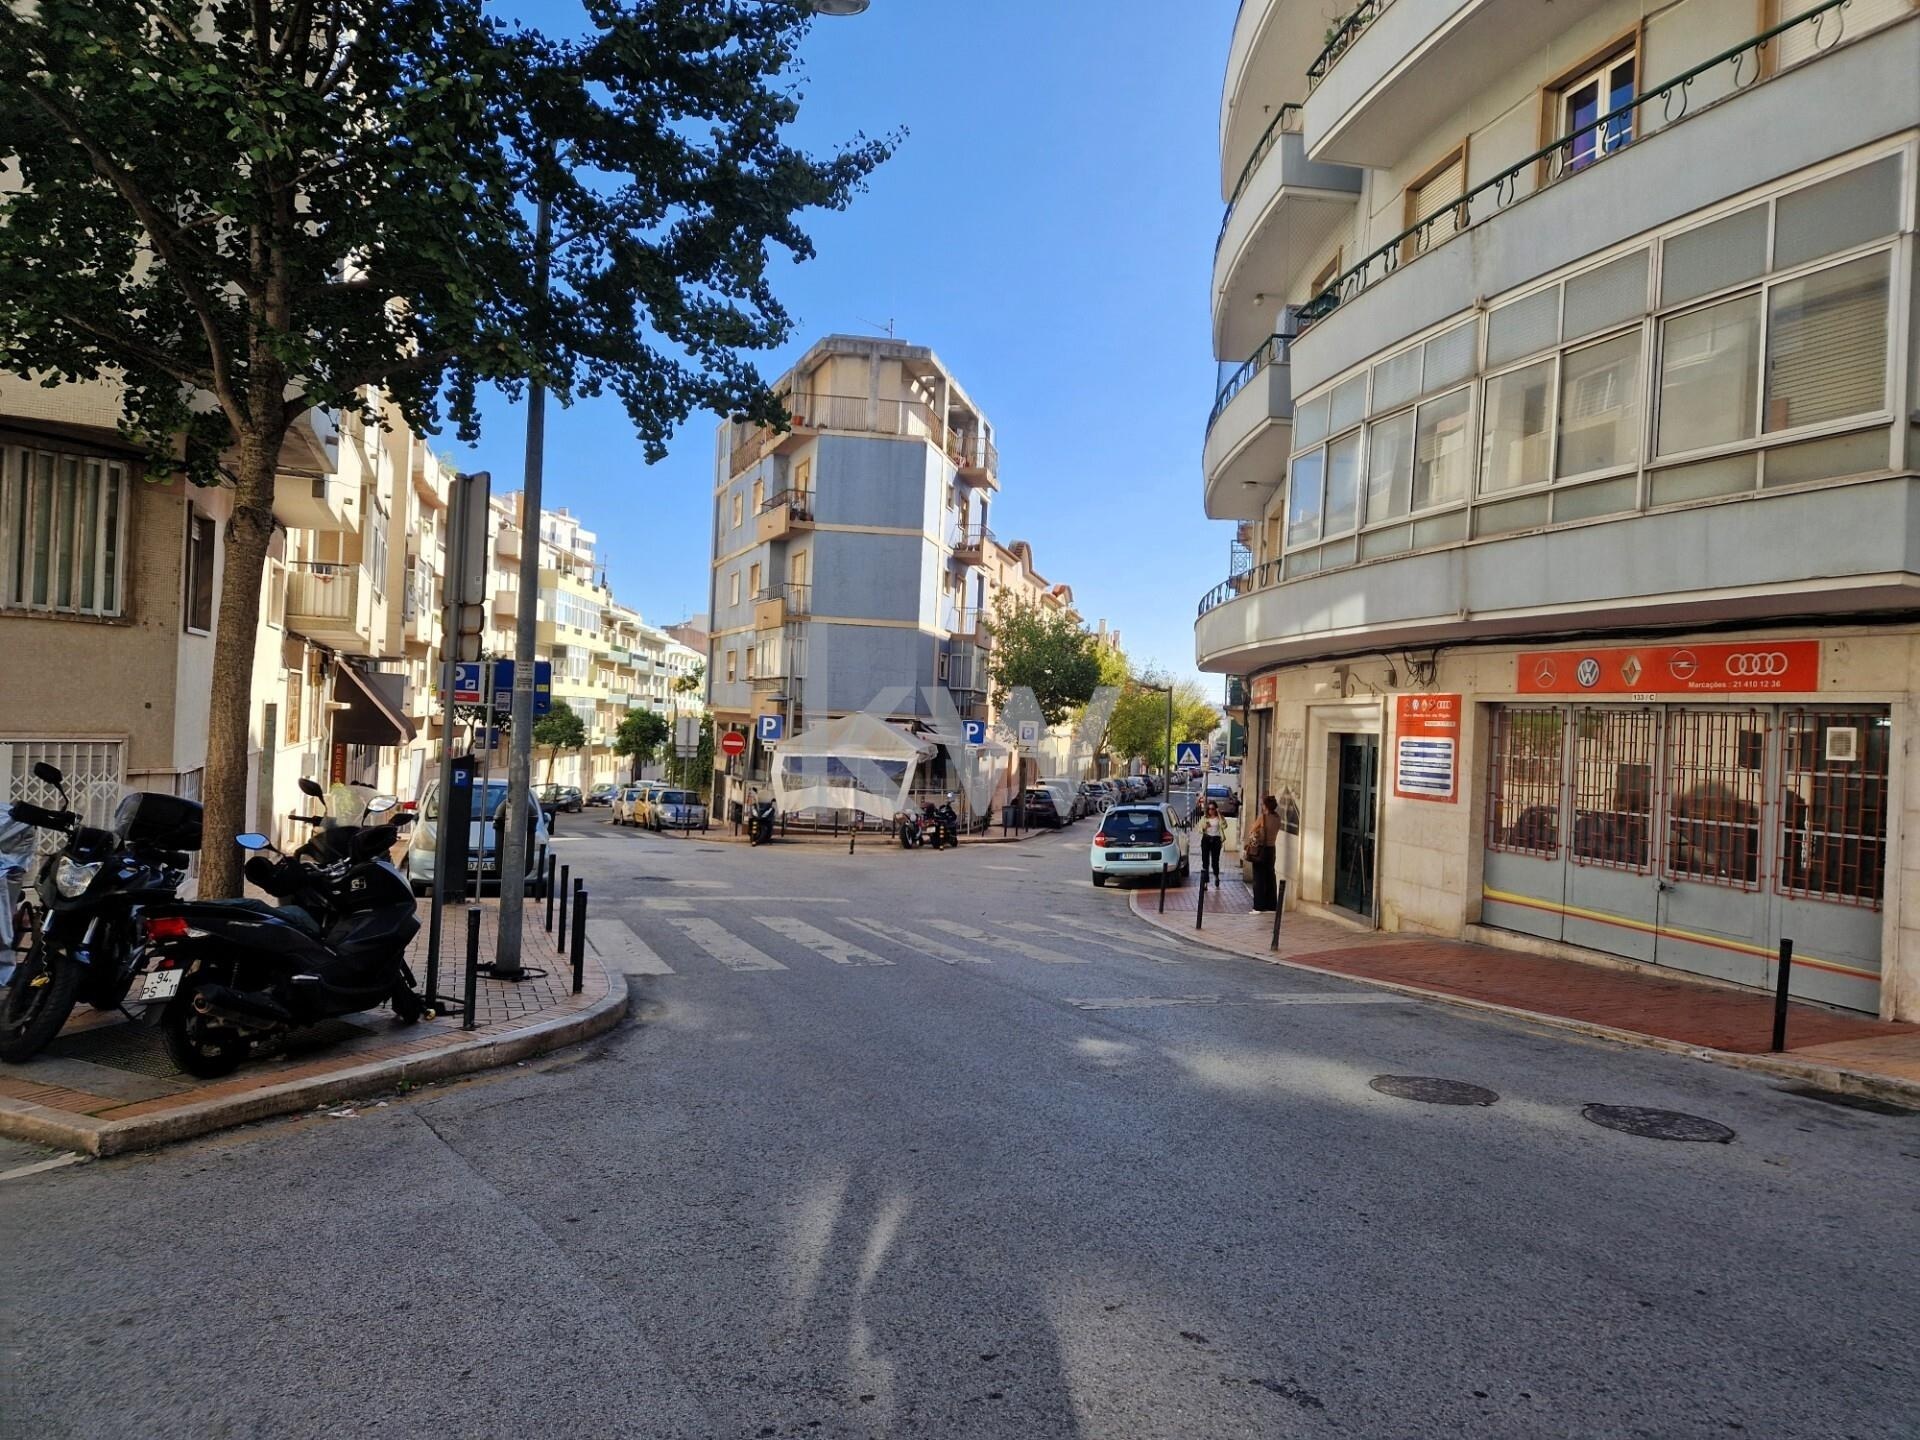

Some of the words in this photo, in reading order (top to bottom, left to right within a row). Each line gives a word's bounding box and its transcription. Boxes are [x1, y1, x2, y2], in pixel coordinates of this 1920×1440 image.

[1688, 681, 1727, 689] Marcações
[1760, 680, 1769, 688] 12
[762, 717, 777, 736] P
[966, 723, 979, 742] P
[455, 771, 466, 784] P
